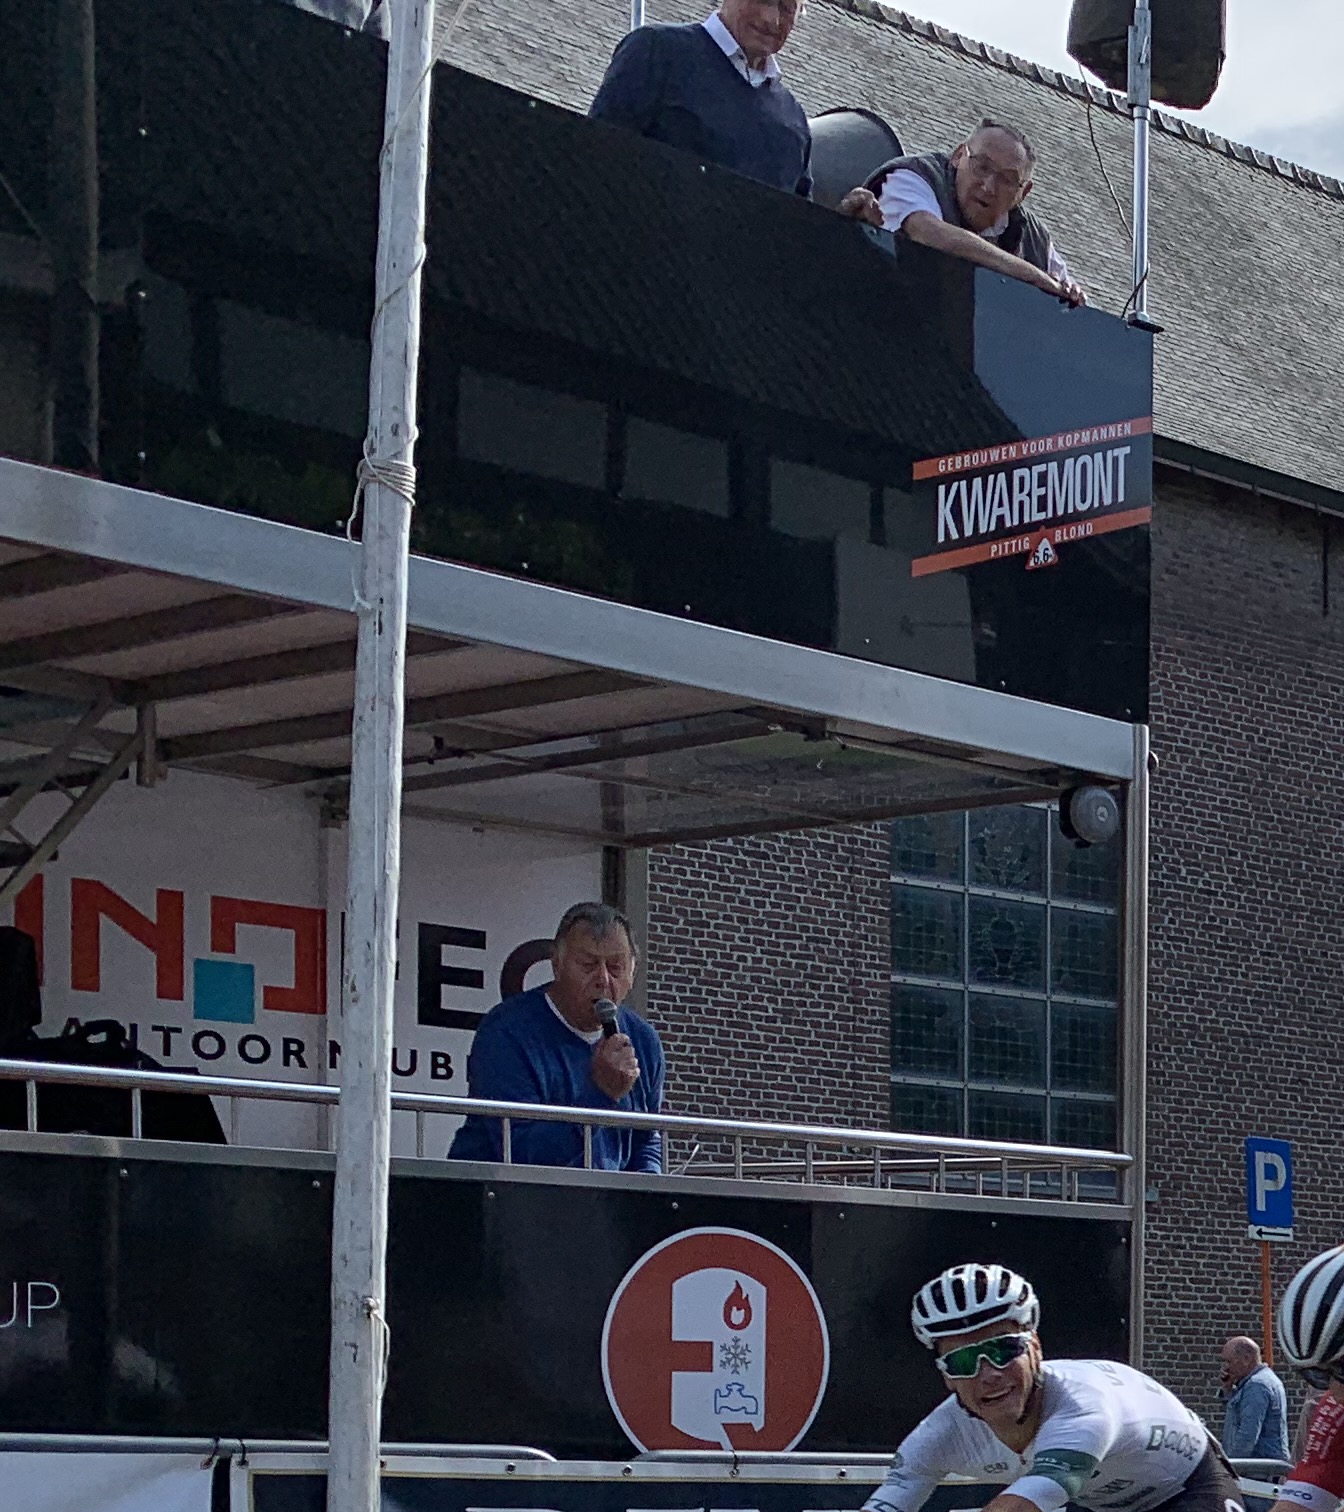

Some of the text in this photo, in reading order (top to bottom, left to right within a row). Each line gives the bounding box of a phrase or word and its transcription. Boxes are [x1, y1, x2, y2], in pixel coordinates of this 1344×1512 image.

[938, 423, 1132, 473] GEBROUWEN VOOR KOPMANNEN
[937, 446, 1131, 543] KWAREMONT
[990, 522, 1093, 557] PITTIG BLOND
[1255, 1151, 1287, 1212] P
